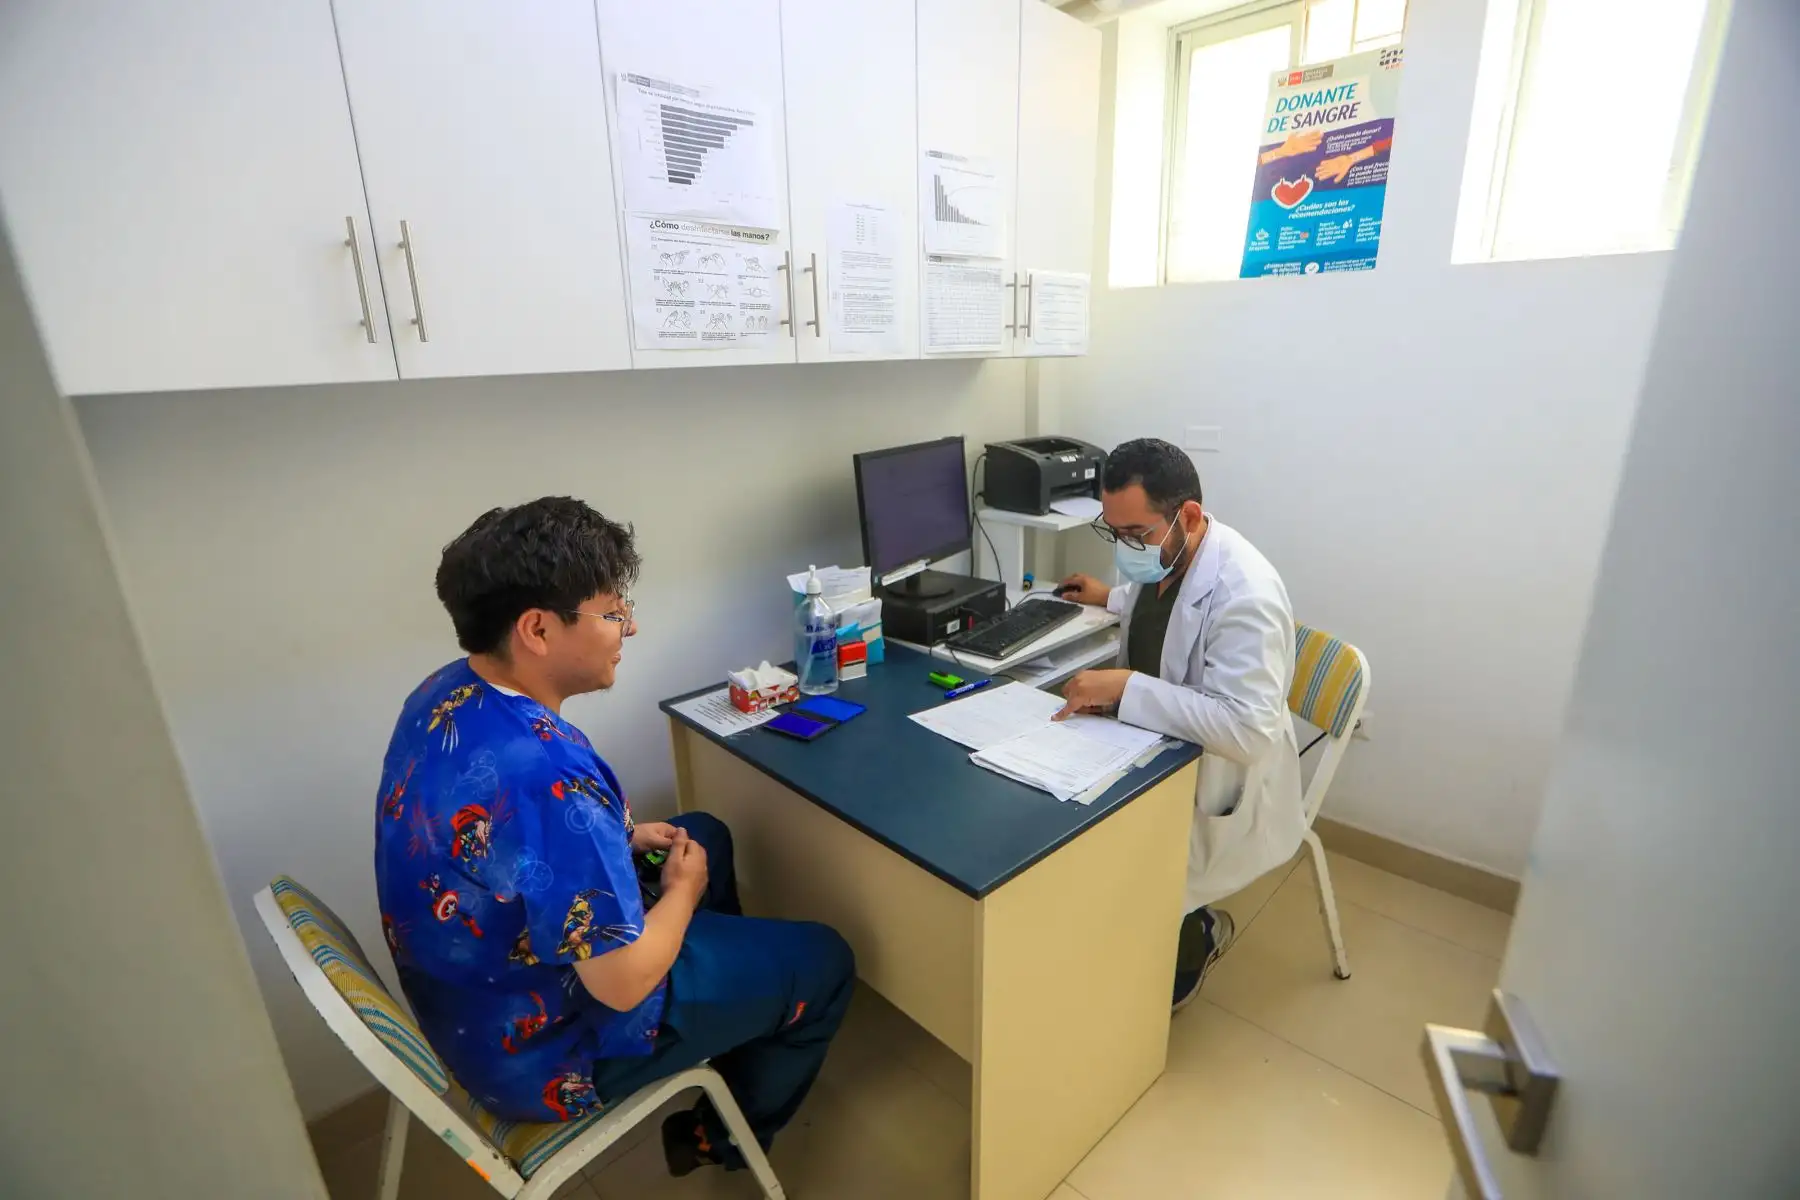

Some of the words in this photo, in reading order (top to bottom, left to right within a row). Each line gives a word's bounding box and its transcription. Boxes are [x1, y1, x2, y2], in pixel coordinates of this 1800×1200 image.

[1276, 82, 1358, 113] DONANTE
[1267, 116, 1289, 133] DE
[1291, 102, 1361, 129] SANGRE
[1289, 204, 1355, 219] recomendaciones?
[649, 220, 679, 230] ¿Cómo
[731, 229, 741, 237] las
[742, 232, 770, 241] manos?
